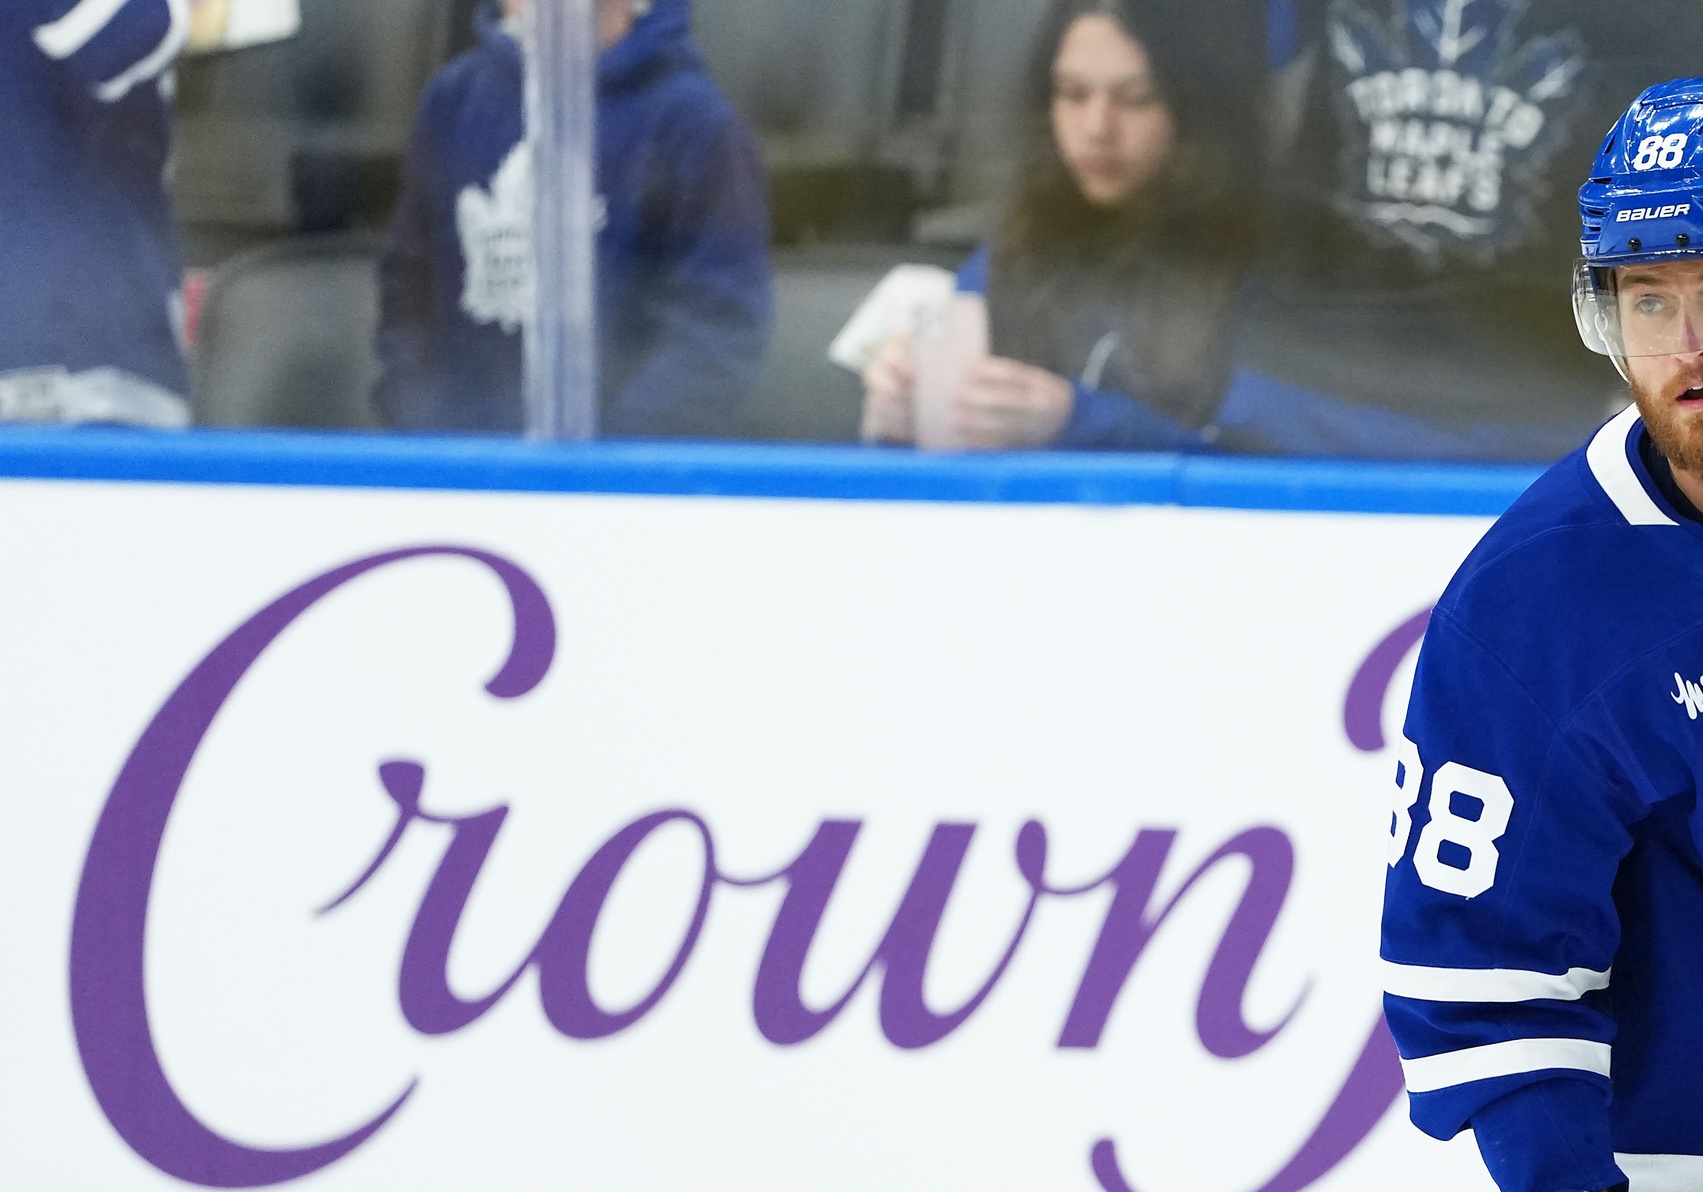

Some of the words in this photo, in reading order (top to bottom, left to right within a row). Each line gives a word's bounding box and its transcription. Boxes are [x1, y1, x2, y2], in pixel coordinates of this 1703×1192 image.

[1346, 67, 1546, 149] TORONTO
[1632, 132, 1689, 172] 88
[1366, 154, 1502, 212] LEAFS
[1615, 203, 1691, 223] BAUER
[68, 543, 1317, 1191] Crown
